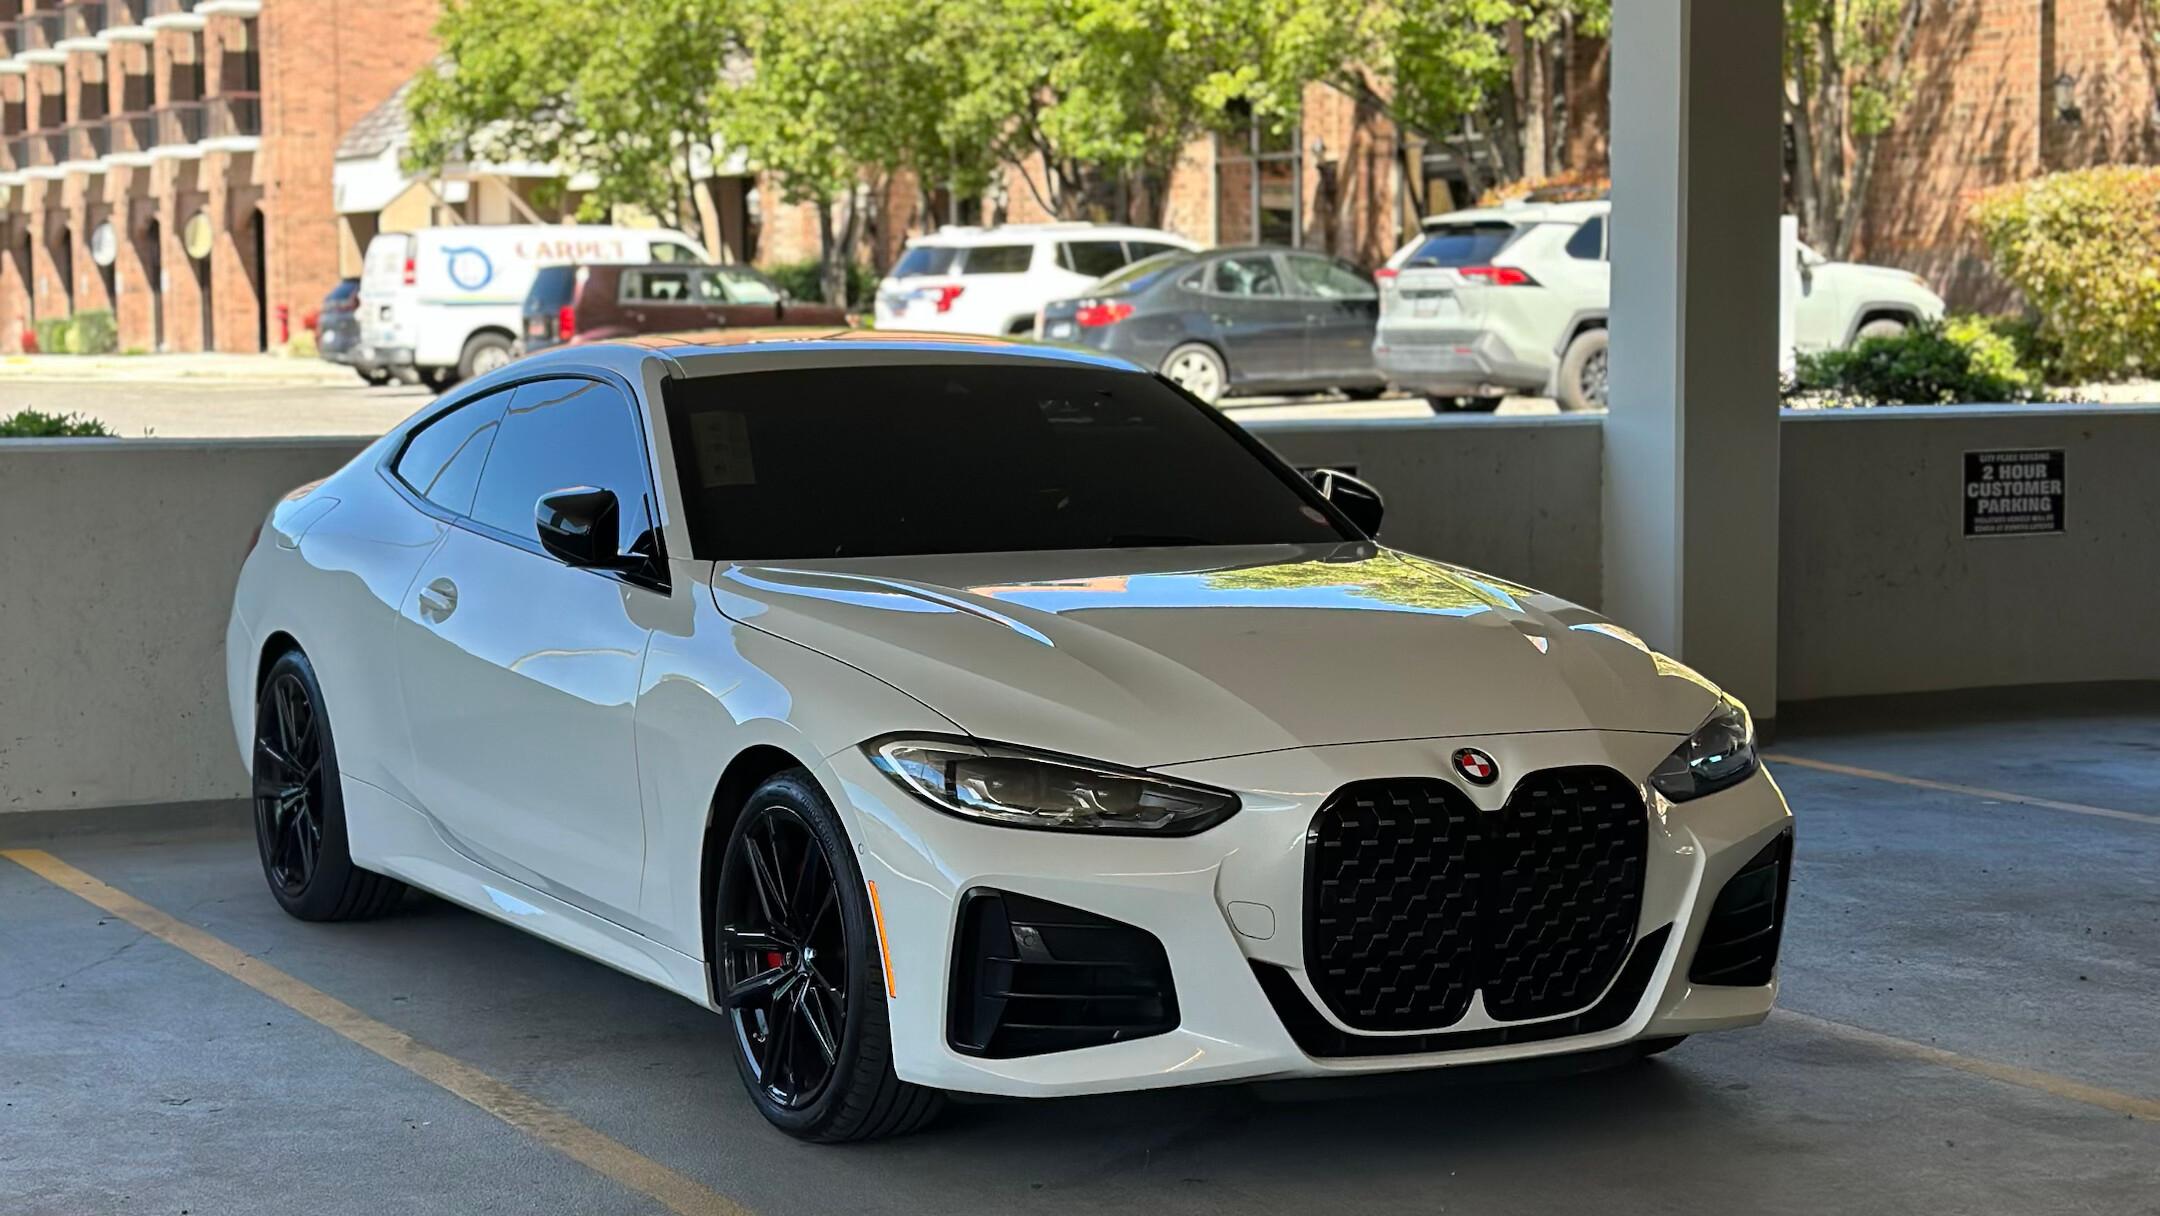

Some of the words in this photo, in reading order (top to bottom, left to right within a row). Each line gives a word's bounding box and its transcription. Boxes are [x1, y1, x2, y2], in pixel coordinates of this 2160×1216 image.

[514, 239, 625, 259] CARPET
[1982, 465, 1994, 480] 2
[1999, 463, 2047, 480] HOUR
[1967, 480, 2062, 498] CUSTOMER
[1977, 497, 2052, 514] PARKING
